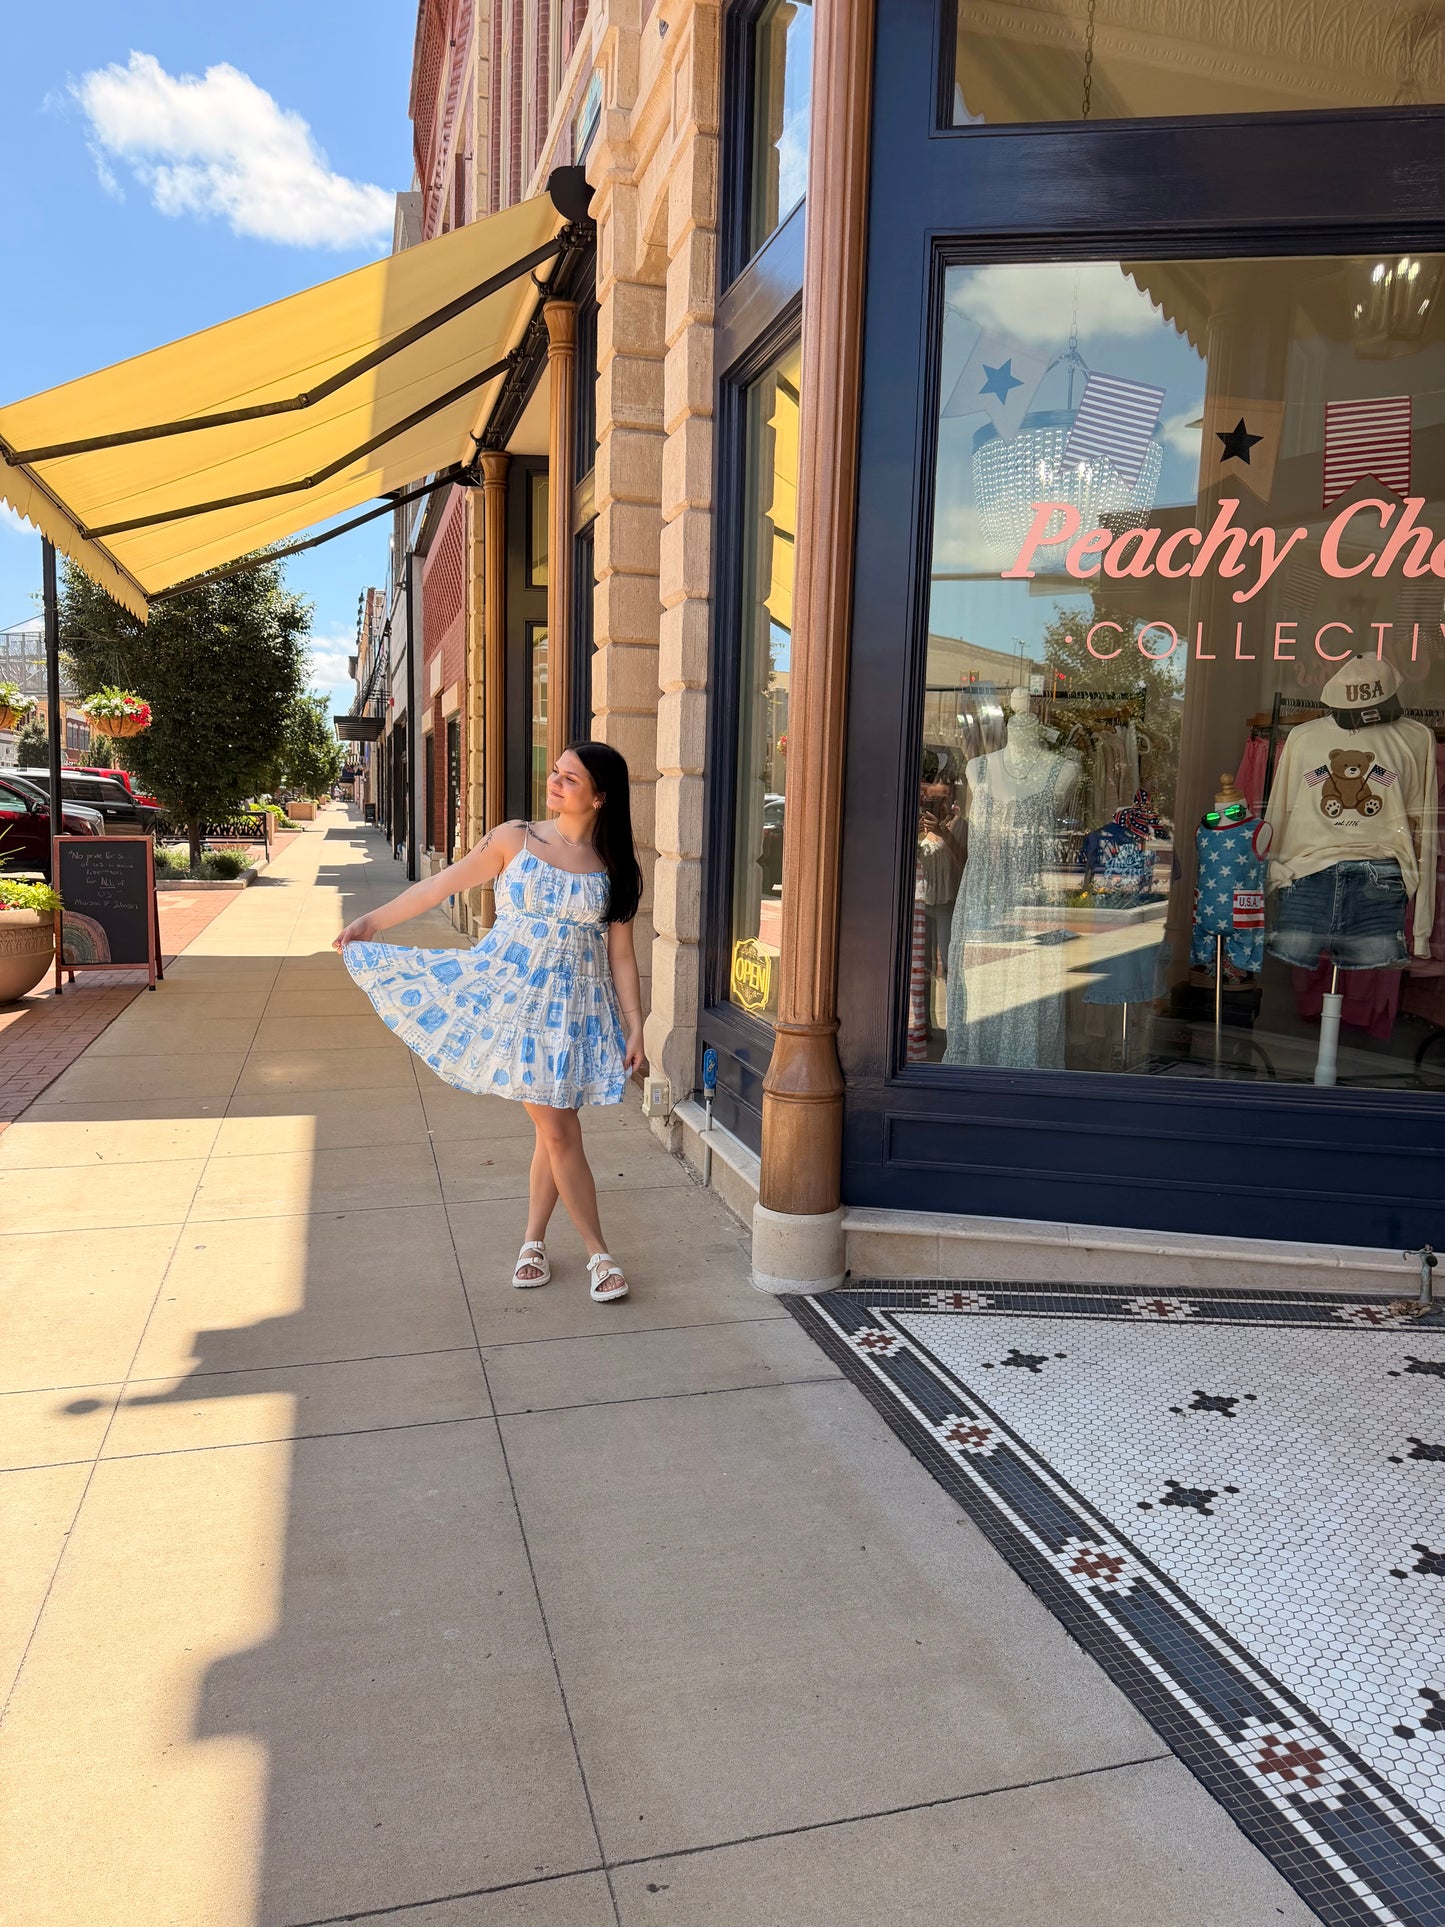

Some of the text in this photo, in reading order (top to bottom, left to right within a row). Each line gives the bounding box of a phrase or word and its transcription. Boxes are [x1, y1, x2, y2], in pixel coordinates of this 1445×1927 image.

[1002, 498, 1307, 603] Peachy
[1086, 621, 1445, 661] COLLECTI
[1345, 680, 1384, 702] USA
[1239, 897, 1259, 907] U.S.A.
[736, 957, 766, 993] OPEN
